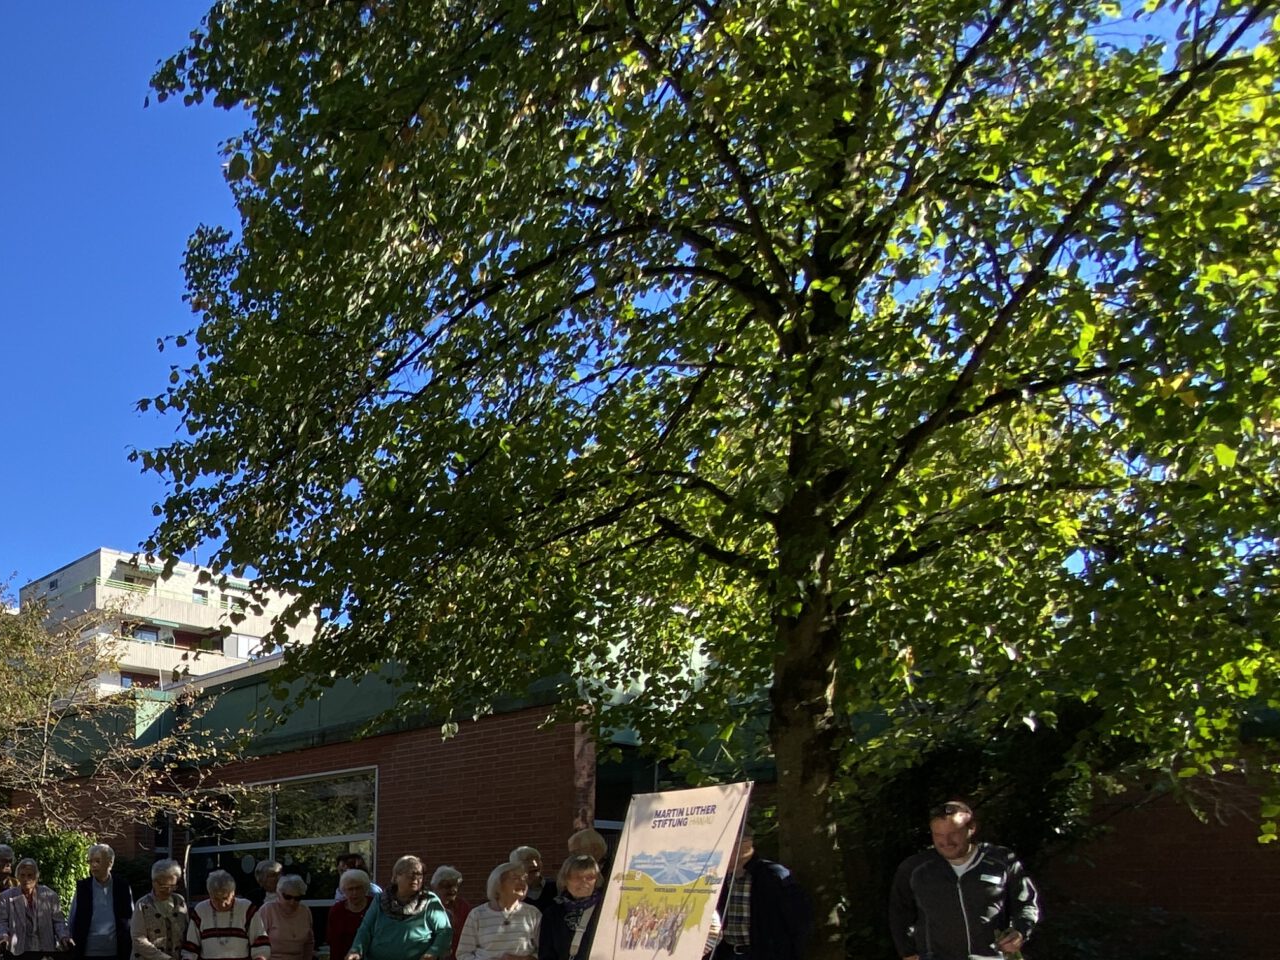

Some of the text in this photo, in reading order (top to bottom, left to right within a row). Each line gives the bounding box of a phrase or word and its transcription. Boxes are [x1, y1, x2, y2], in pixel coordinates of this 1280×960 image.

[654, 804, 717, 819] MARTIN LUTHER
[651, 817, 688, 829] STIFTUNG
